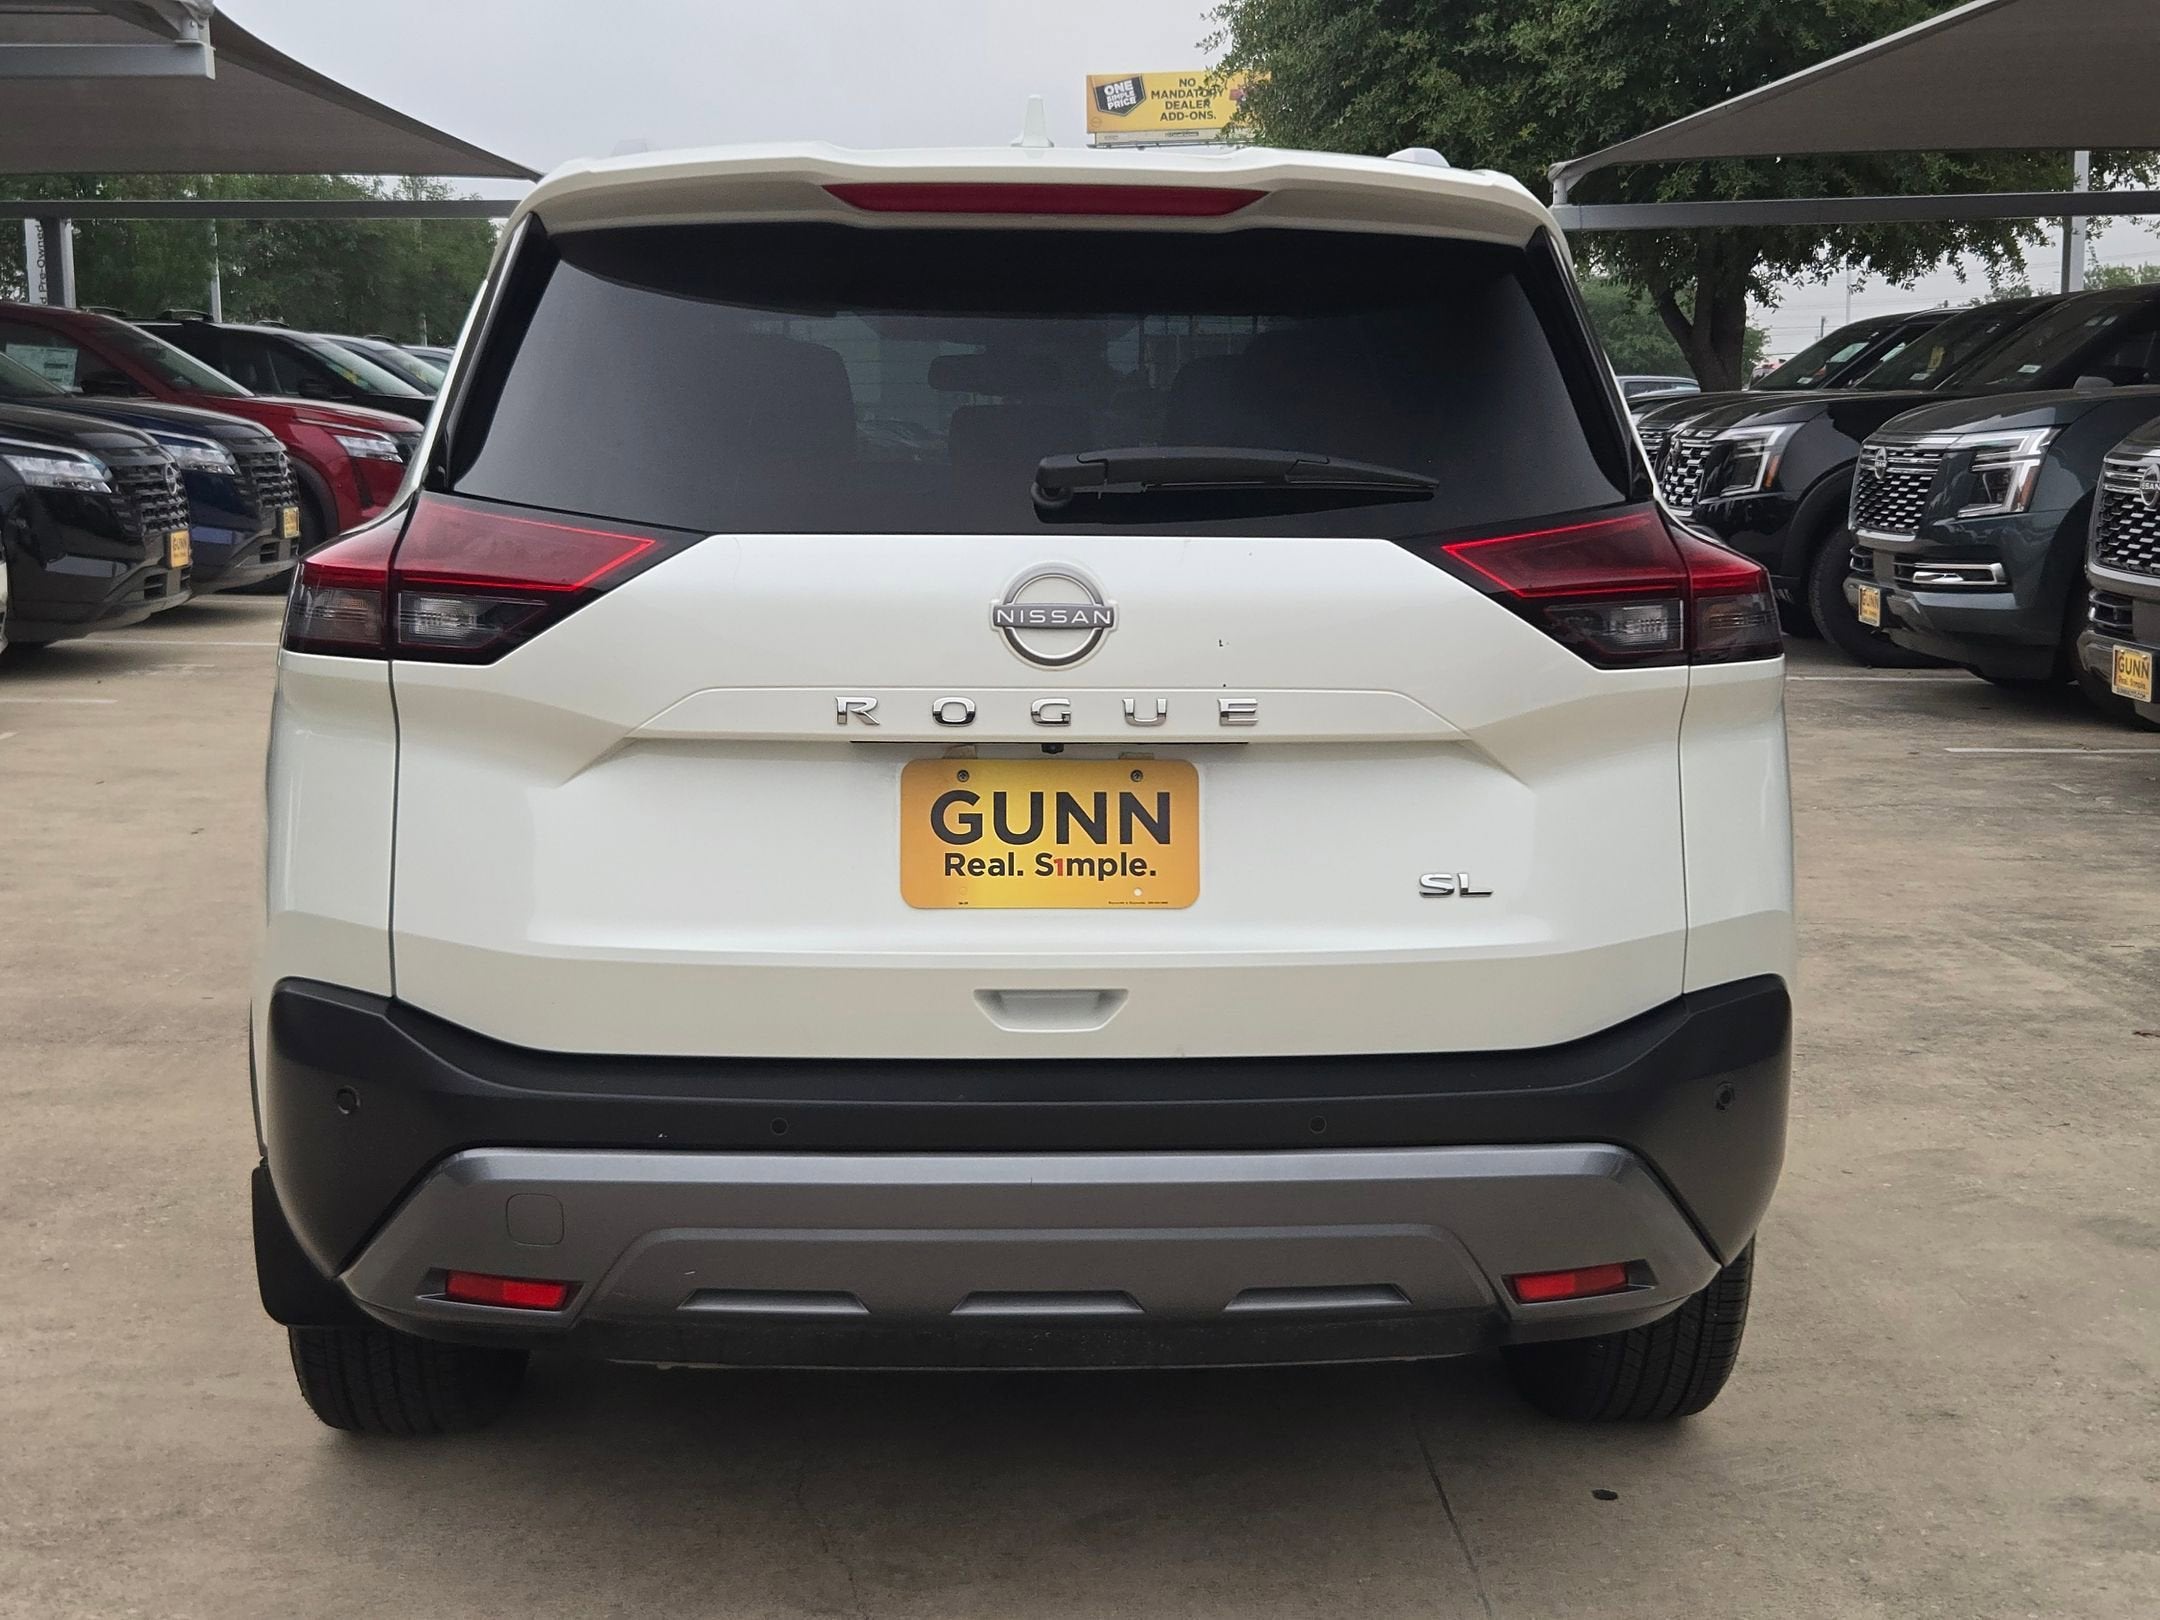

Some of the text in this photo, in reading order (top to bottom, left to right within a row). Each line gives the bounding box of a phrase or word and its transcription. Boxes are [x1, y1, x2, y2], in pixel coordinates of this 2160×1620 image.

[1104, 80, 1133, 96] ONE
[1179, 78, 1196, 88] NO
[1106, 90, 1135, 102] SIMPLE
[1151, 88, 1224, 100] MANDATORY
[1107, 96, 1137, 110] PRICE
[1165, 99, 1210, 110] DEALER
[1160, 111, 1217, 121] ADD-ONS.
[997, 609, 1111, 624] NISSAN
[2118, 656, 2149, 680] GUNN
[835, 696, 1259, 727] ROGUE
[930, 789, 1171, 846] GUNN
[944, 851, 1157, 881] Real. S1mple.
[1419, 872, 1494, 898] SL
